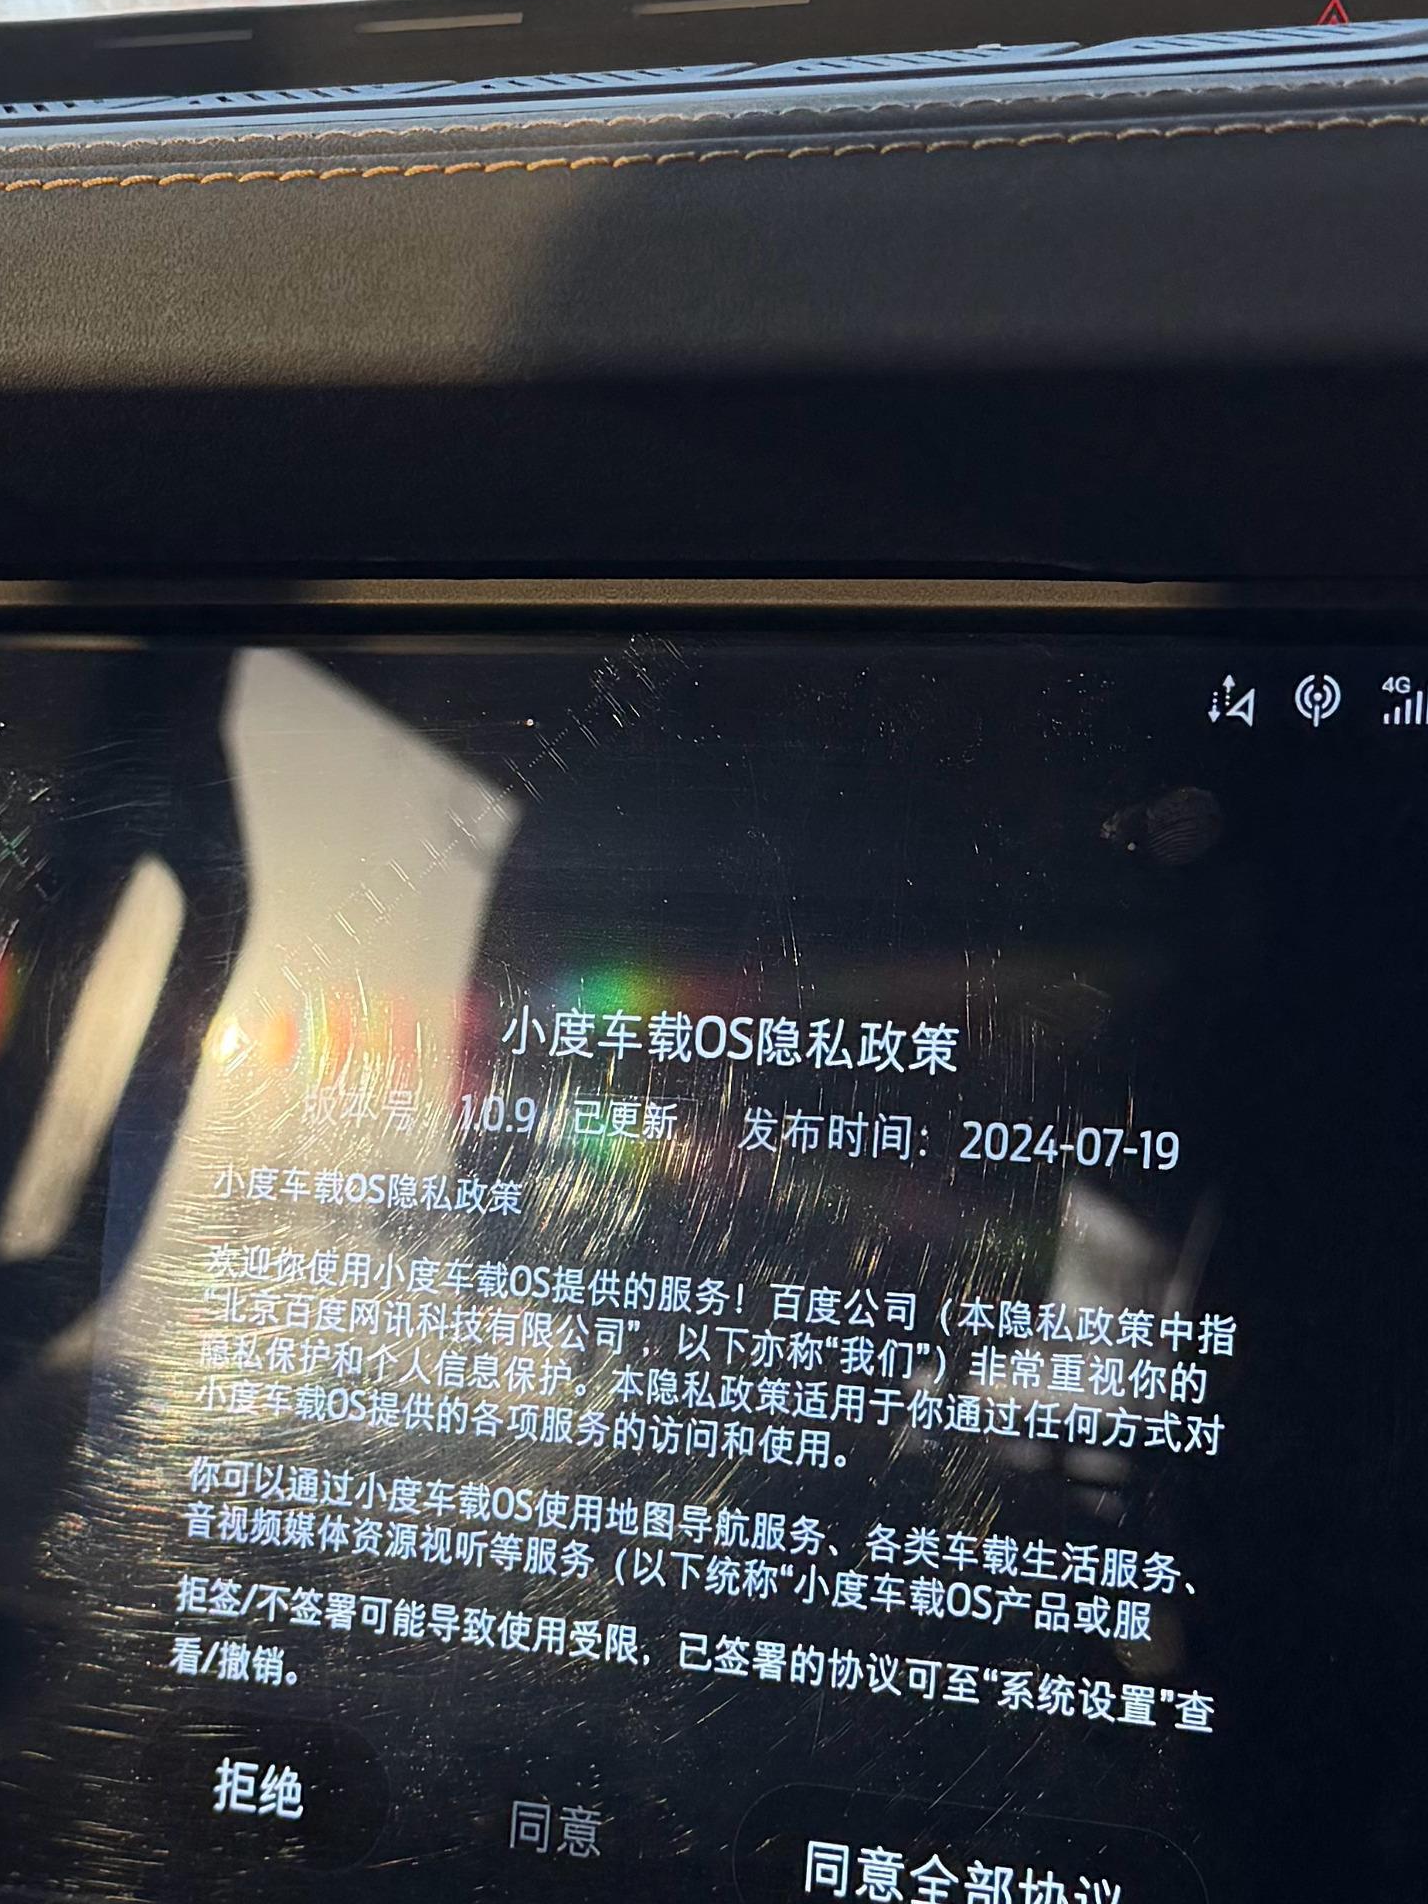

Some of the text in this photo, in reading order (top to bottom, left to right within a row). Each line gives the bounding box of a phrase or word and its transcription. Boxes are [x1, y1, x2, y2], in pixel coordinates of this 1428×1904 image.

[1381, 676, 1411, 694] 4G
[502, 1004, 960, 1075] 小度车载OS隐私政策
[573, 1099, 678, 1141] 已更新
[960, 1119, 1181, 1171] 2024-07-19
[213, 1165, 523, 1216] 小度车载OS隐私政策
[212, 1756, 304, 1820] 拒绝
[508, 1799, 603, 1859] 同意
